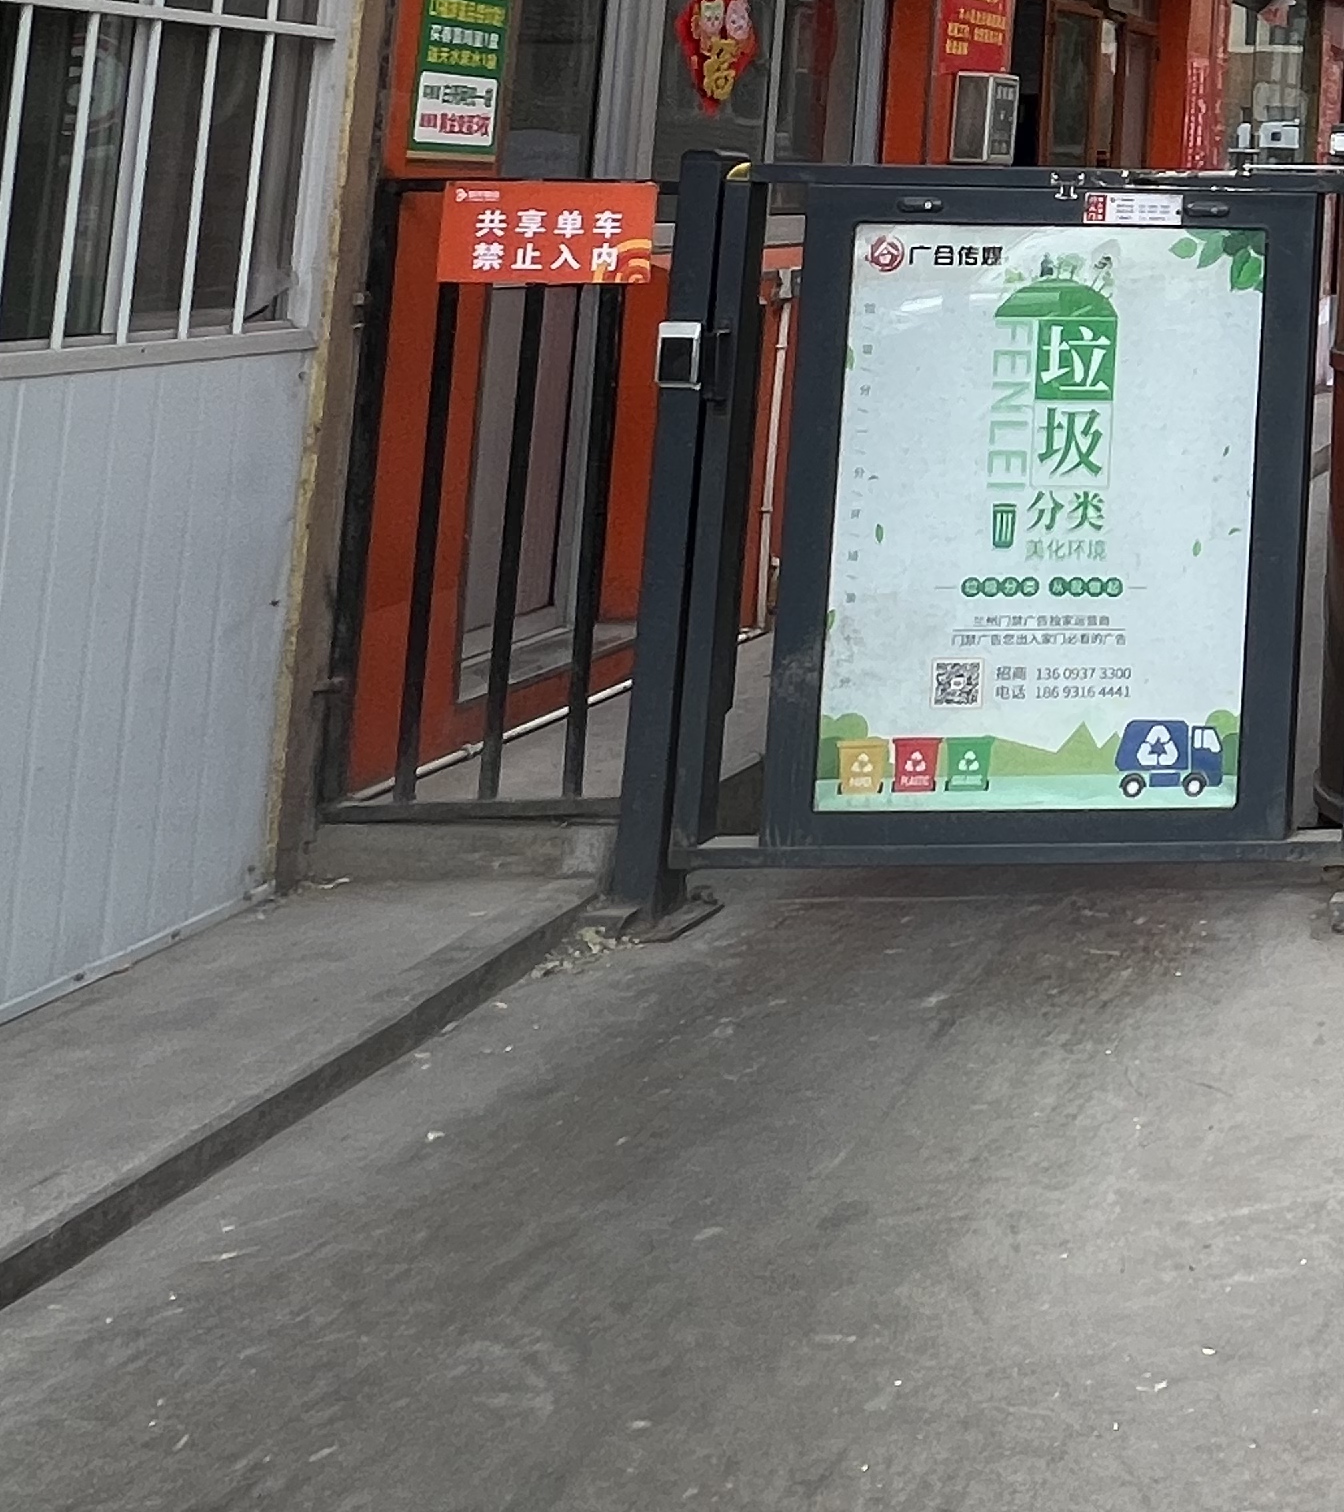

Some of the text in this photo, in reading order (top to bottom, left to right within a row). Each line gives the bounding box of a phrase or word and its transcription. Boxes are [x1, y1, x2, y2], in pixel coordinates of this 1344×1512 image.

[475, 209, 623, 239] 共享单车
[472, 243, 619, 272] 禁止入内
[1037, 325, 1112, 478] 垃圾
[1026, 490, 1106, 532] 分类
[1025, 538, 1107, 562] 美化环境
[995, 666, 1132, 681] 招商 136 0937 3300
[995, 684, 1131, 700] 电话 186 9316 4441
